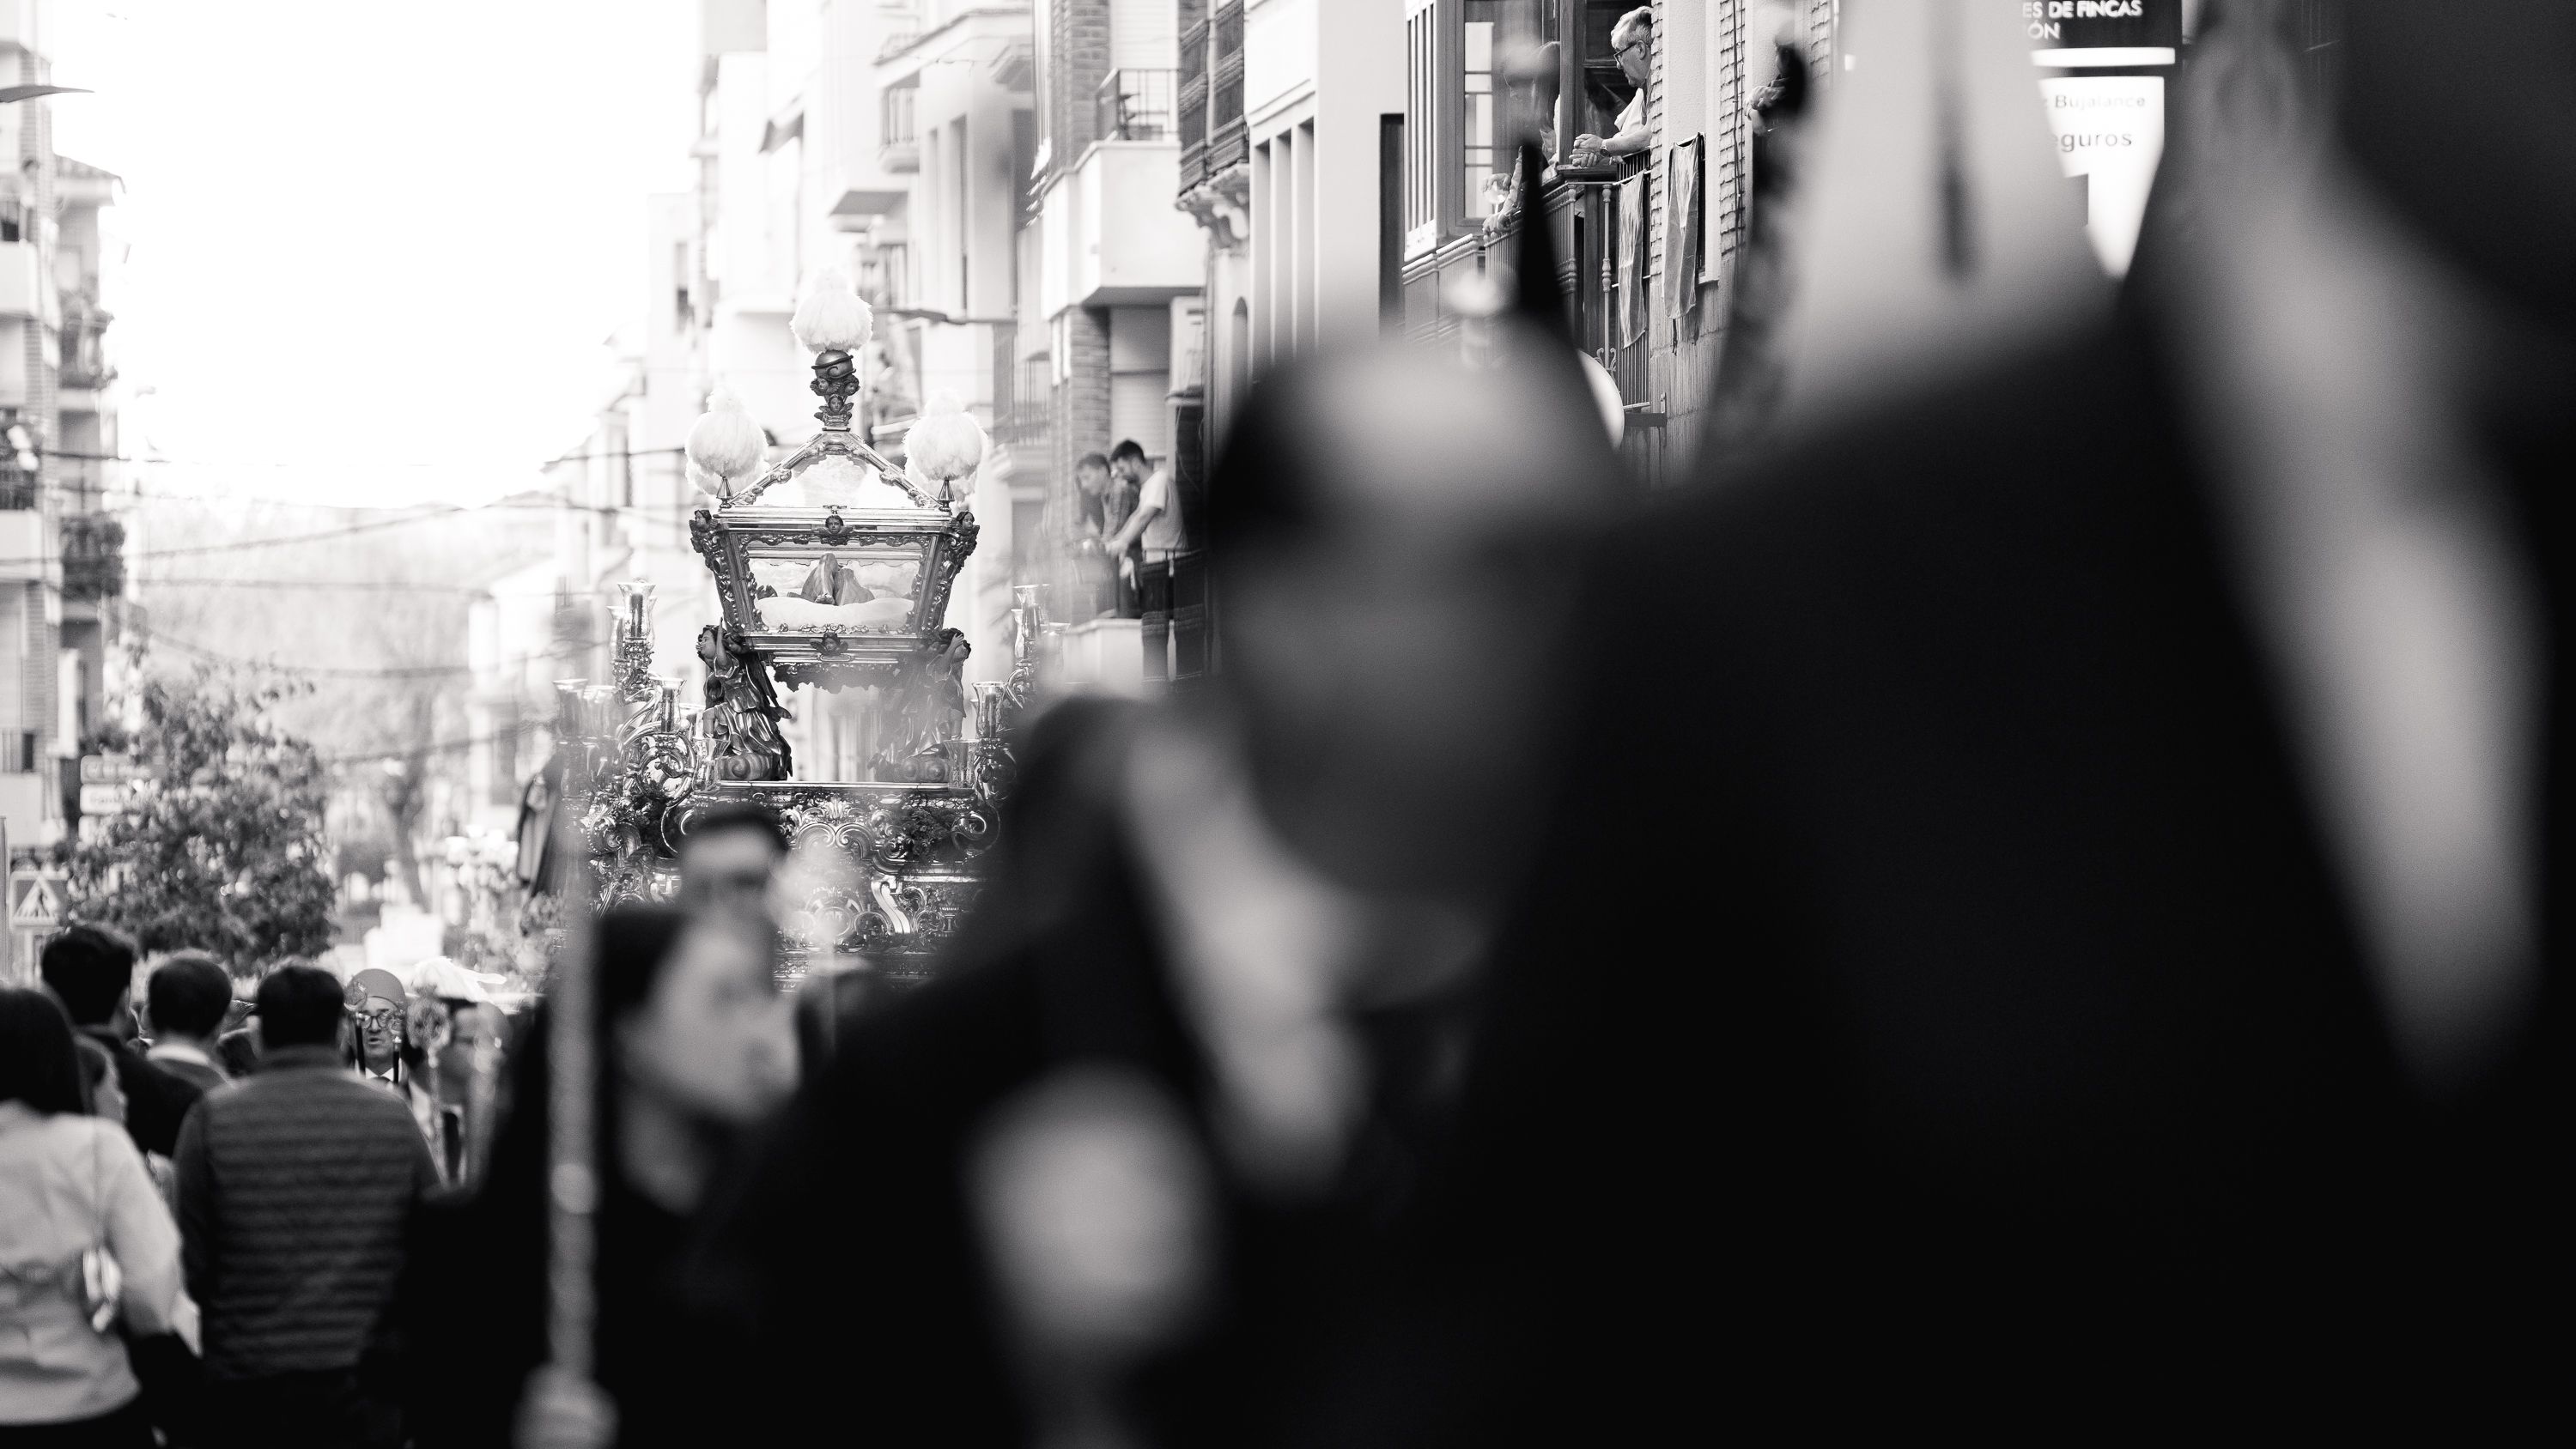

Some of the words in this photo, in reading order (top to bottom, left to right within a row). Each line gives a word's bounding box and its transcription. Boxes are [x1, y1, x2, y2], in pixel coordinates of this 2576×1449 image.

[2048, 1, 2074, 18] DE
[2076, 0, 2142, 17] FINCAS
[2055, 94, 2146, 110] Bujalance
